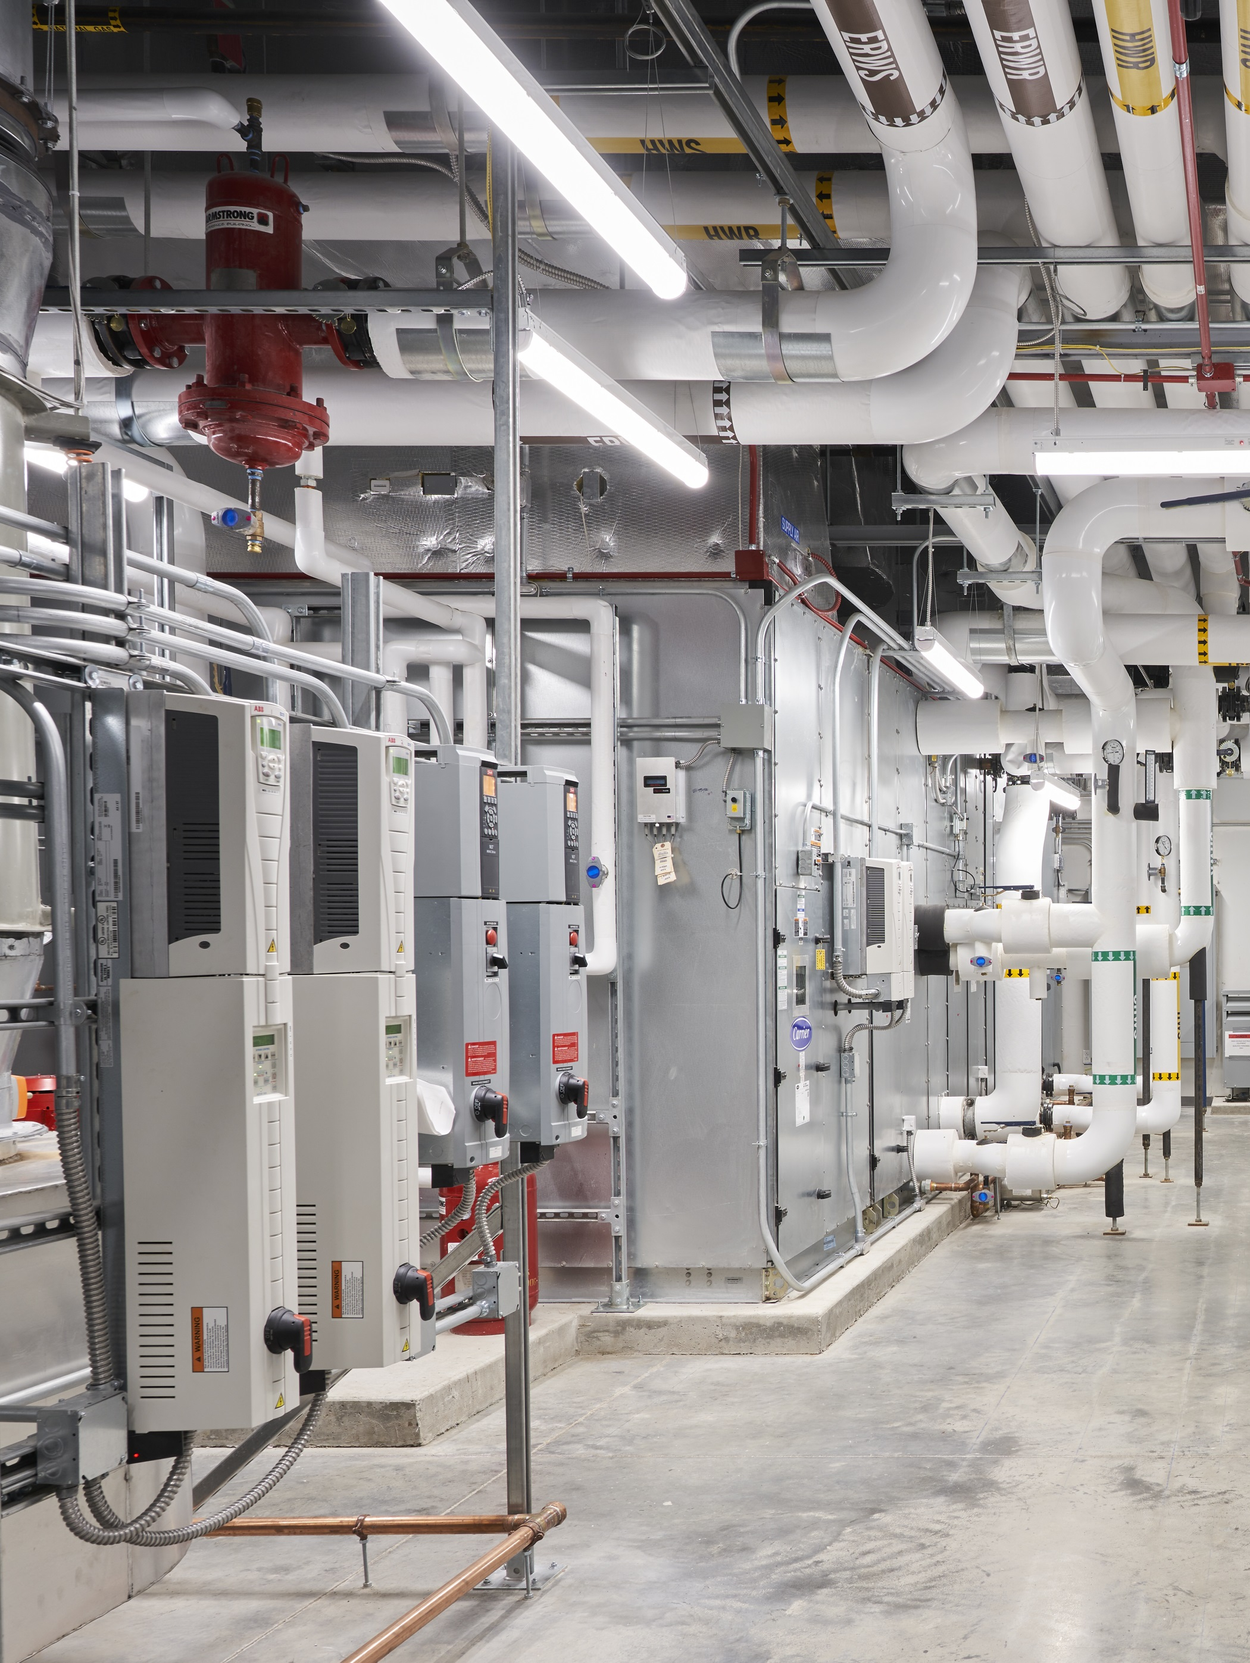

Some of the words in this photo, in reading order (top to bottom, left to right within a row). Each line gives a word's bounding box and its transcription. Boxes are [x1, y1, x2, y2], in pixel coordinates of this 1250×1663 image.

[840, 29, 900, 82] ERWS
[992, 27, 1047, 81] ERWR
[1111, 27, 1156, 71] HWR
[193, 1316, 201, 1353] WARNING
